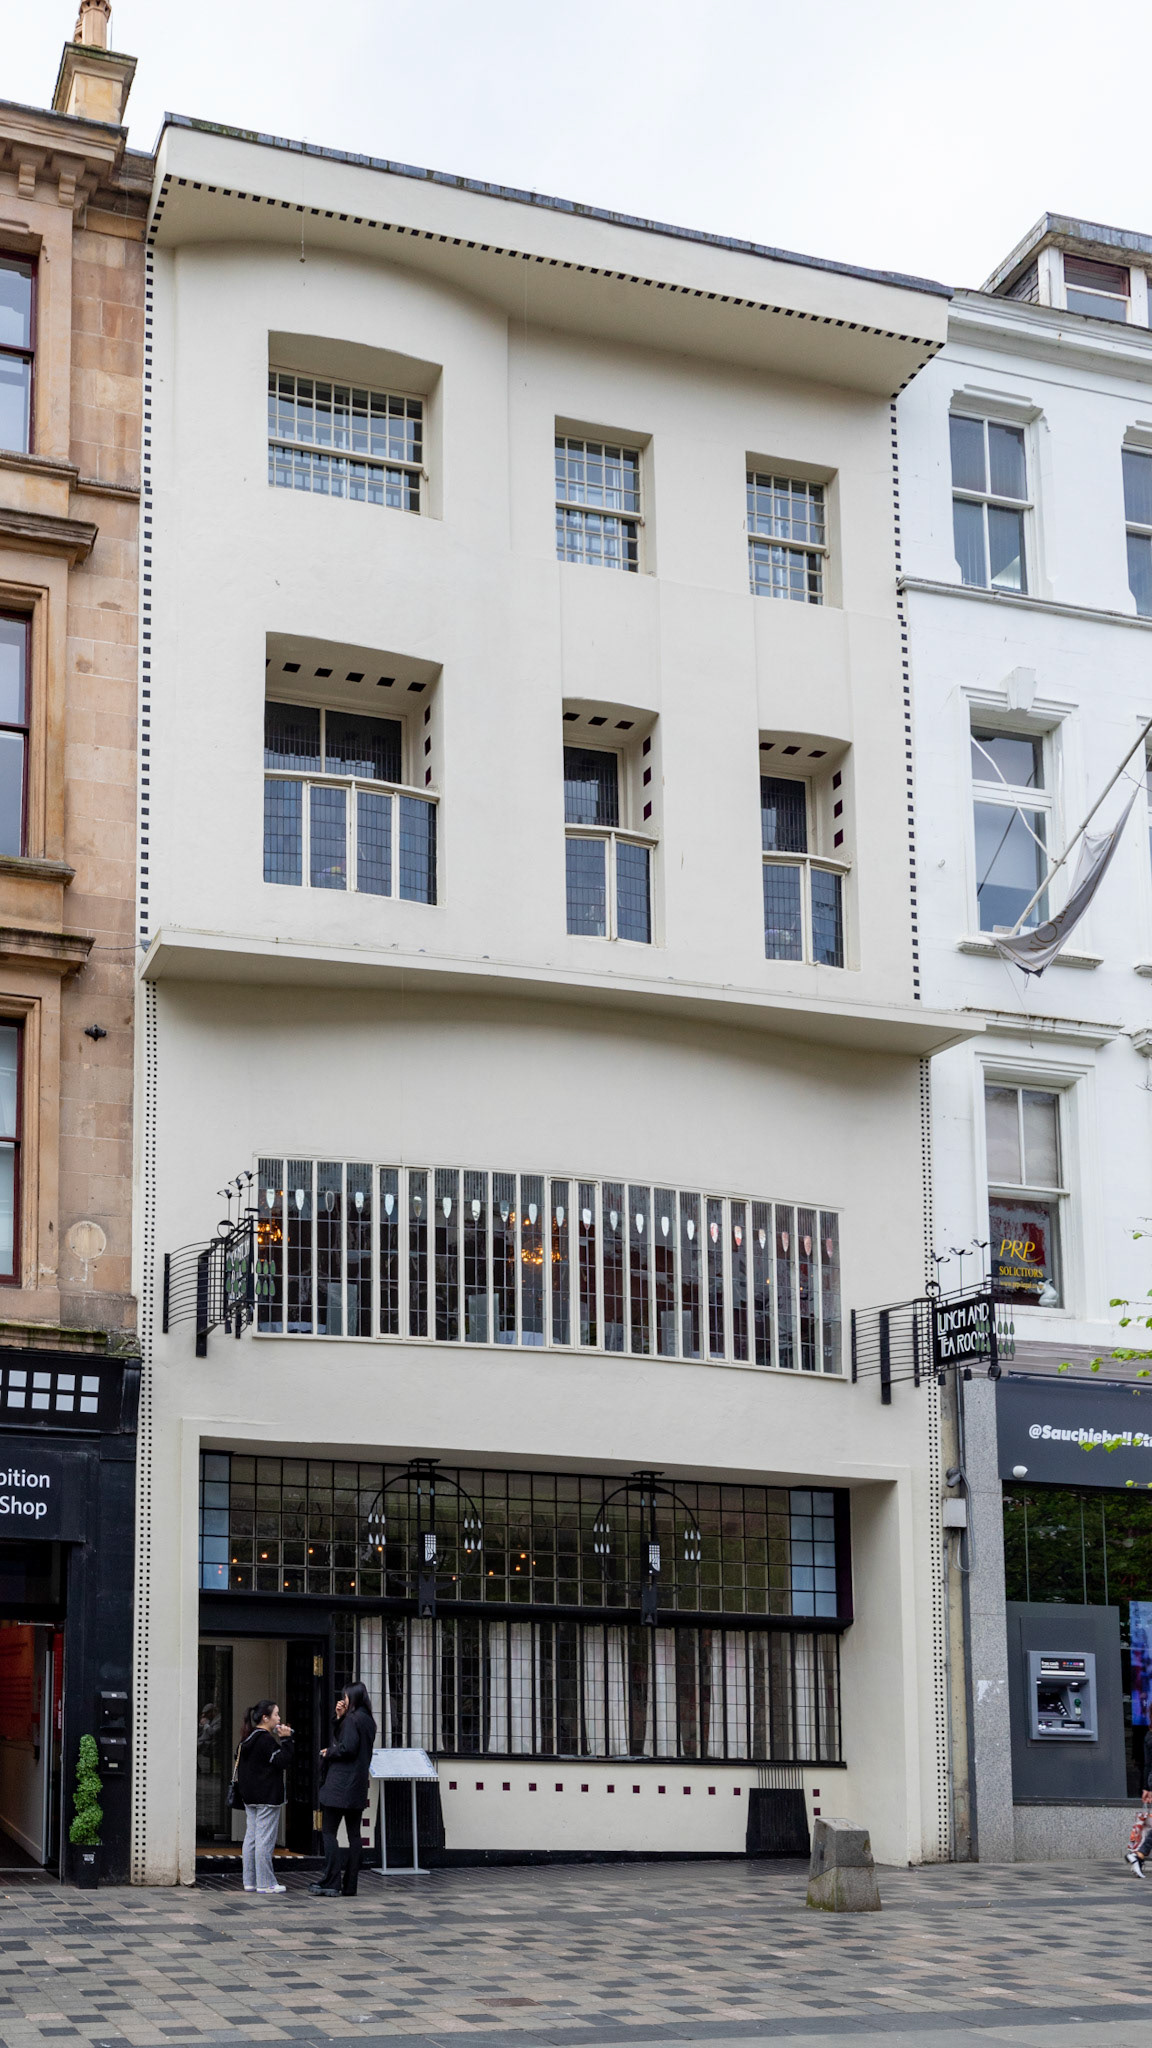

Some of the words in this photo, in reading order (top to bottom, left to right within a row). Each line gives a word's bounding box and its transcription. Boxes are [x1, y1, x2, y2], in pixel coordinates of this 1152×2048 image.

[1000, 1239, 1042, 1262] PRP
[999, 1266, 1043, 1277] SOLICITORS
[937, 1308, 966, 1336] LUNCH
[967, 1302, 990, 1326] AND
[937, 1336, 956, 1358] TEA
[0, 1495, 47, 1519] Shop
